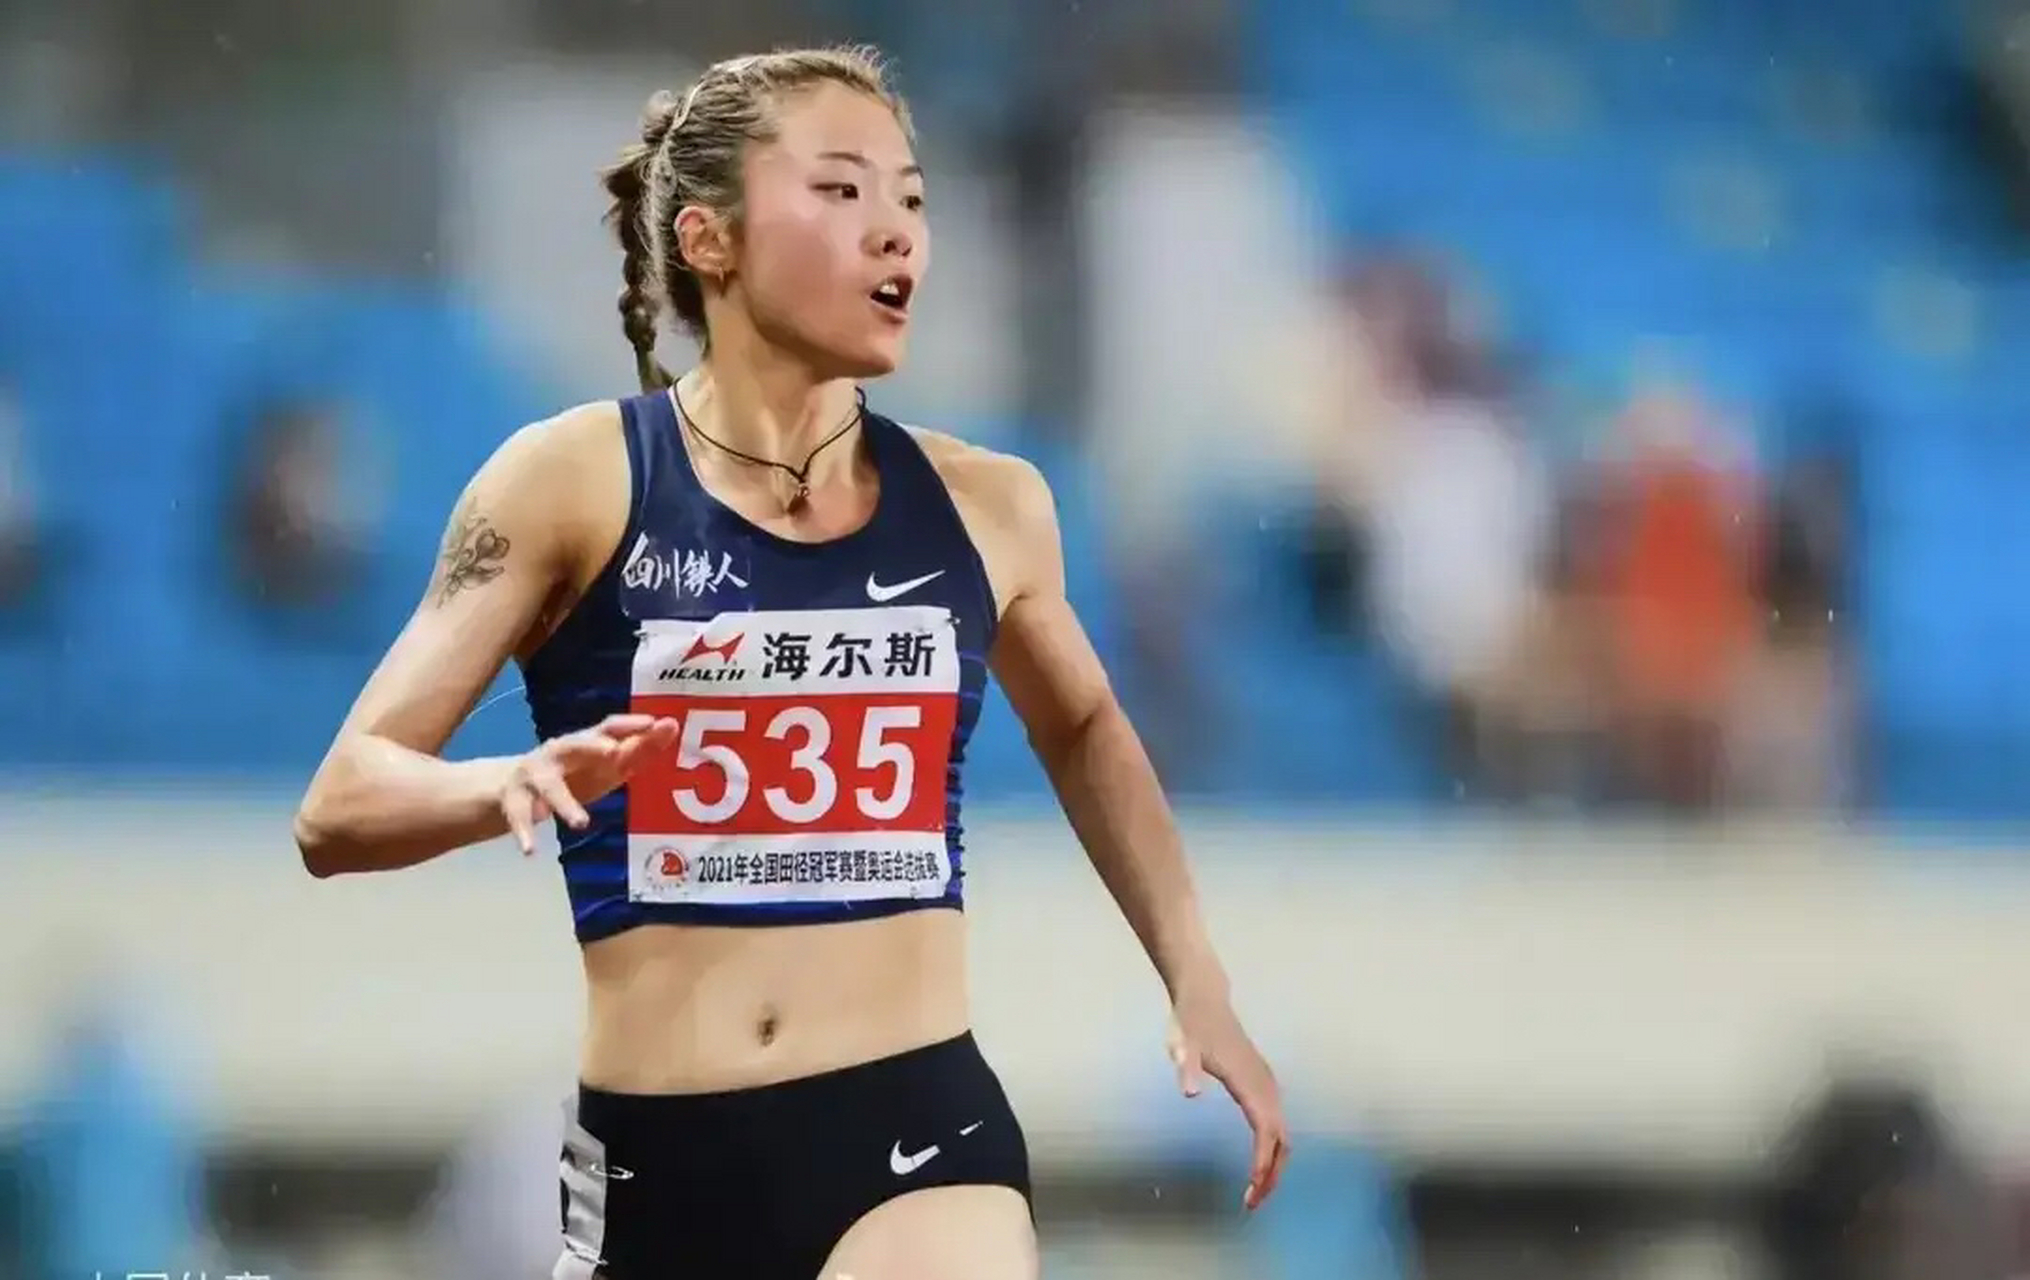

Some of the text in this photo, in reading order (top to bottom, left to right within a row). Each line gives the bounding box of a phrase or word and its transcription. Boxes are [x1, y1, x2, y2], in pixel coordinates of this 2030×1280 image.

[659, 668, 746, 682] HEALTH
[762, 632, 937, 681] 海尔斯
[672, 706, 922, 824] 535
